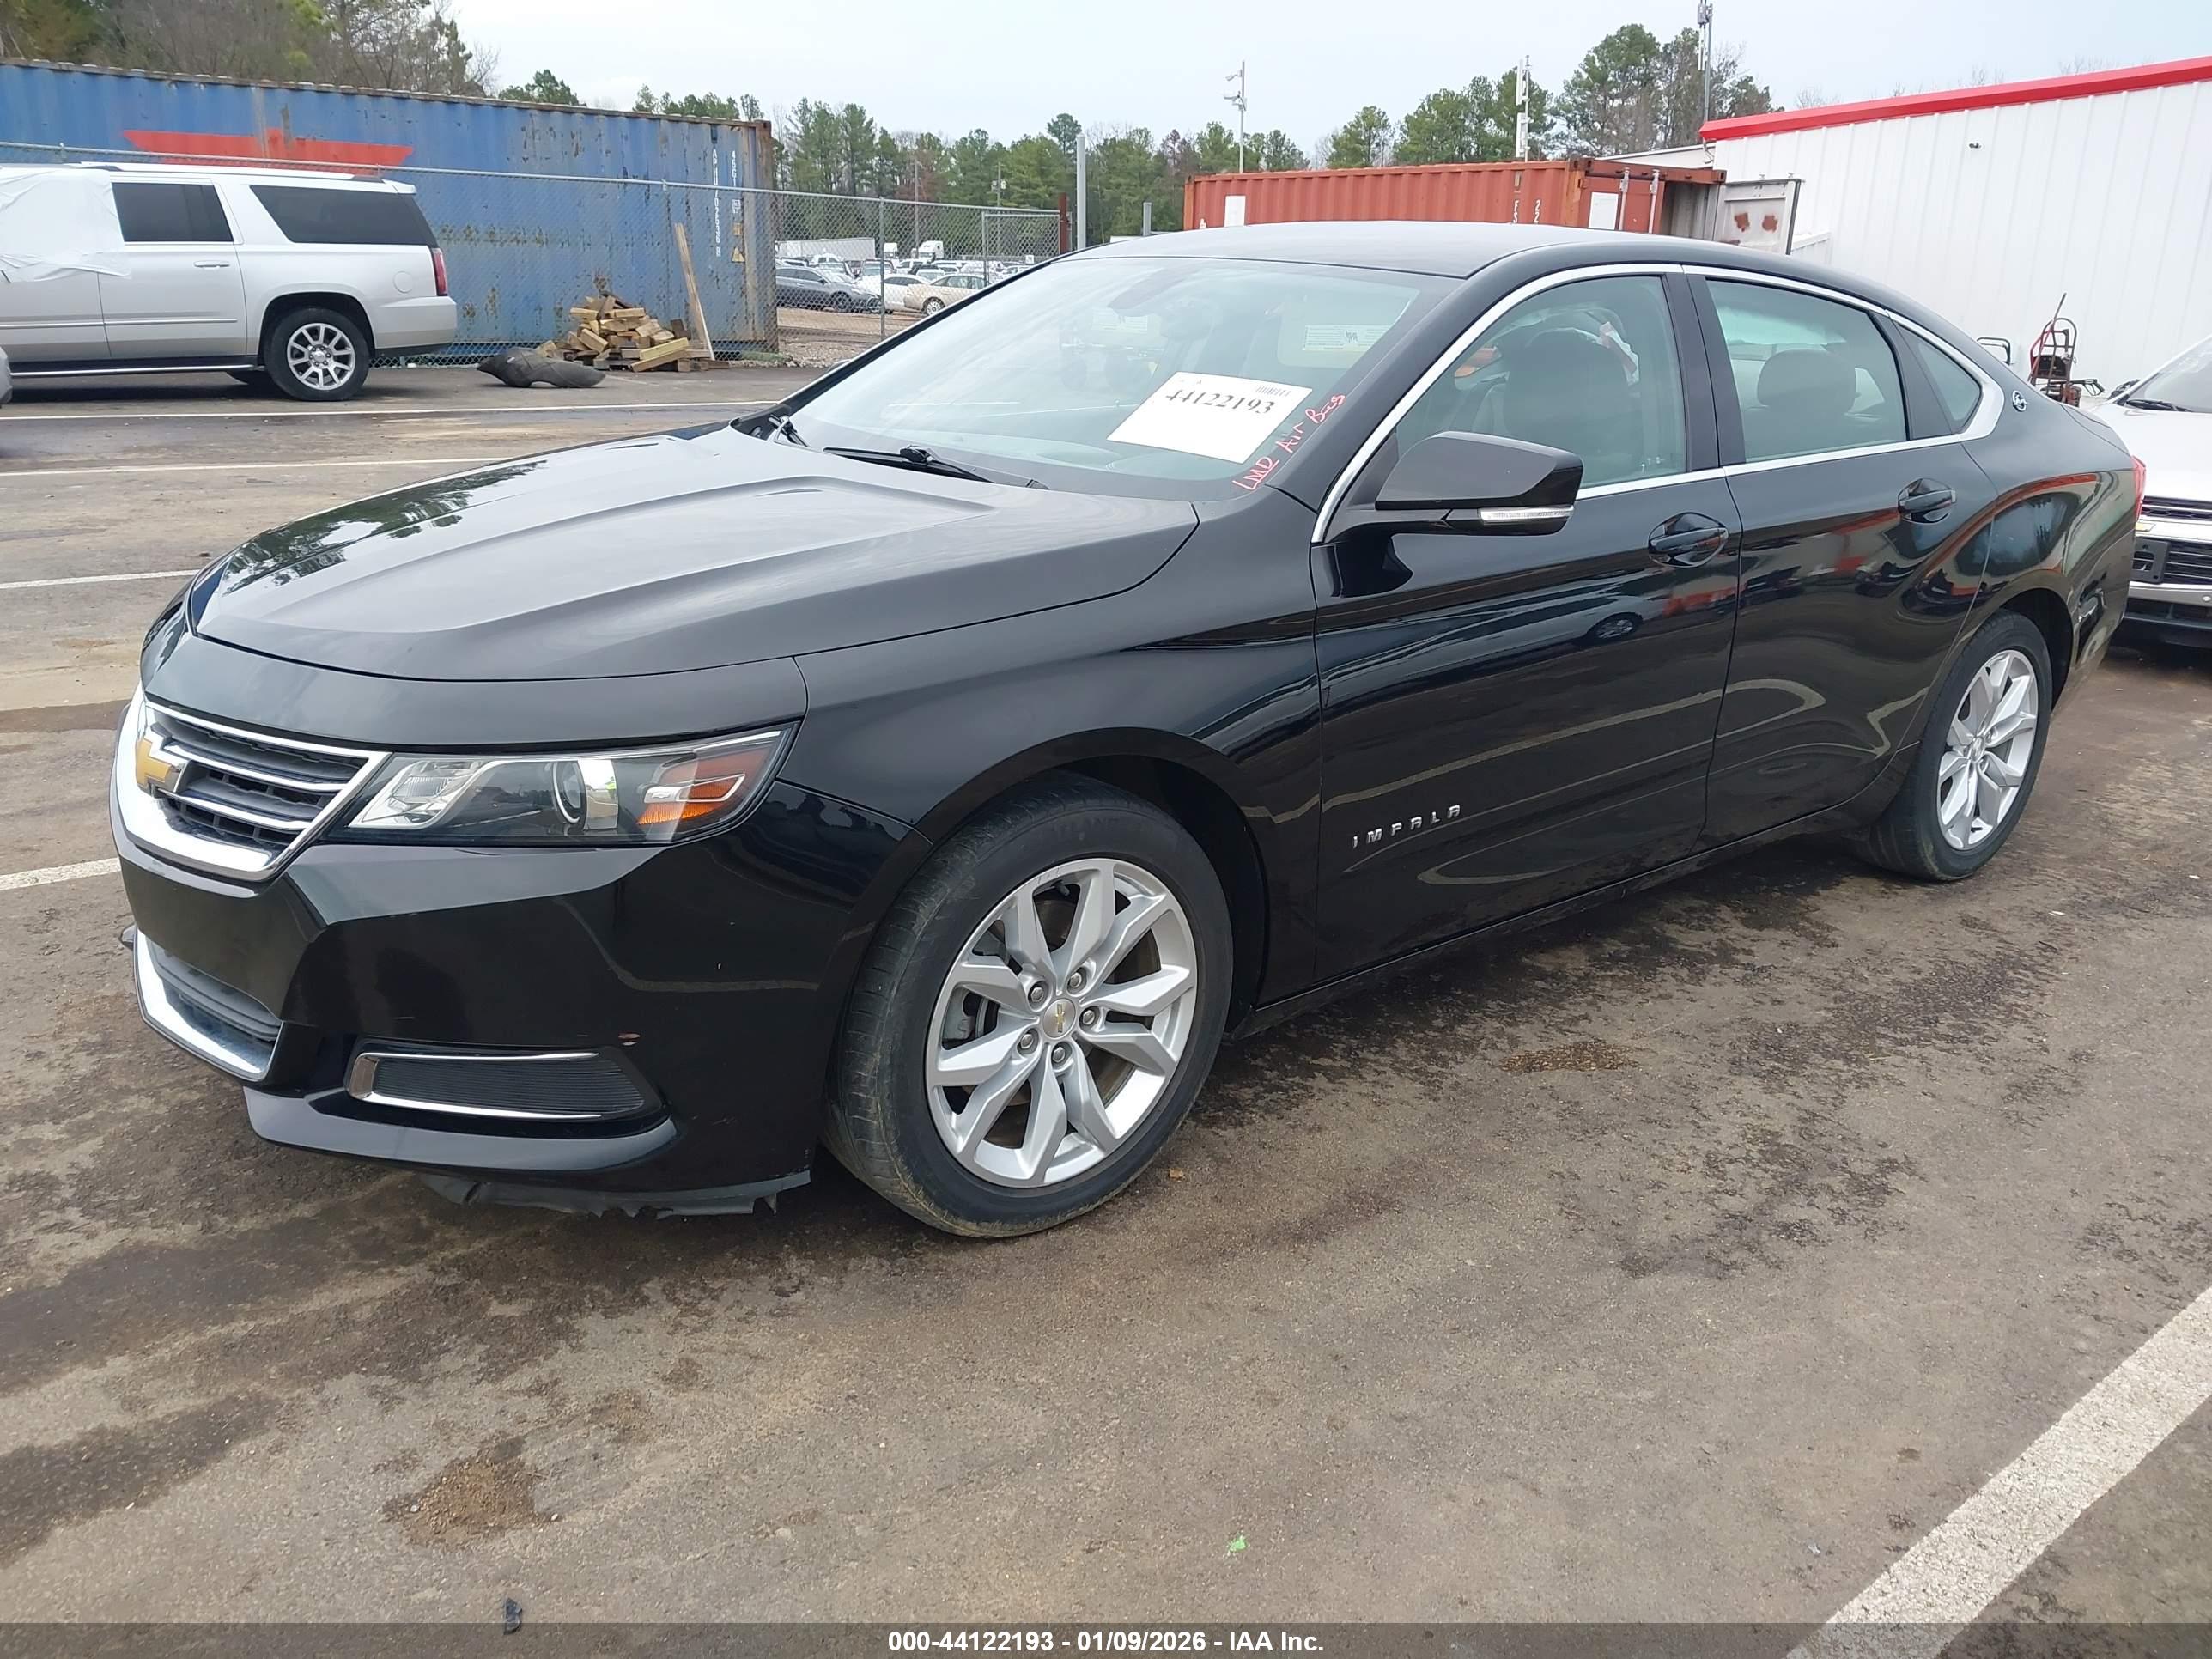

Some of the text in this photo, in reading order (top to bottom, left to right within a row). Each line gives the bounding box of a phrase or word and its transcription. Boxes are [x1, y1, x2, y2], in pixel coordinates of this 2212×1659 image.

[1165, 389, 1276, 414] 44122193
[1275, 421, 1305, 453] Air
[1352, 805, 1461, 848] IMPALA
